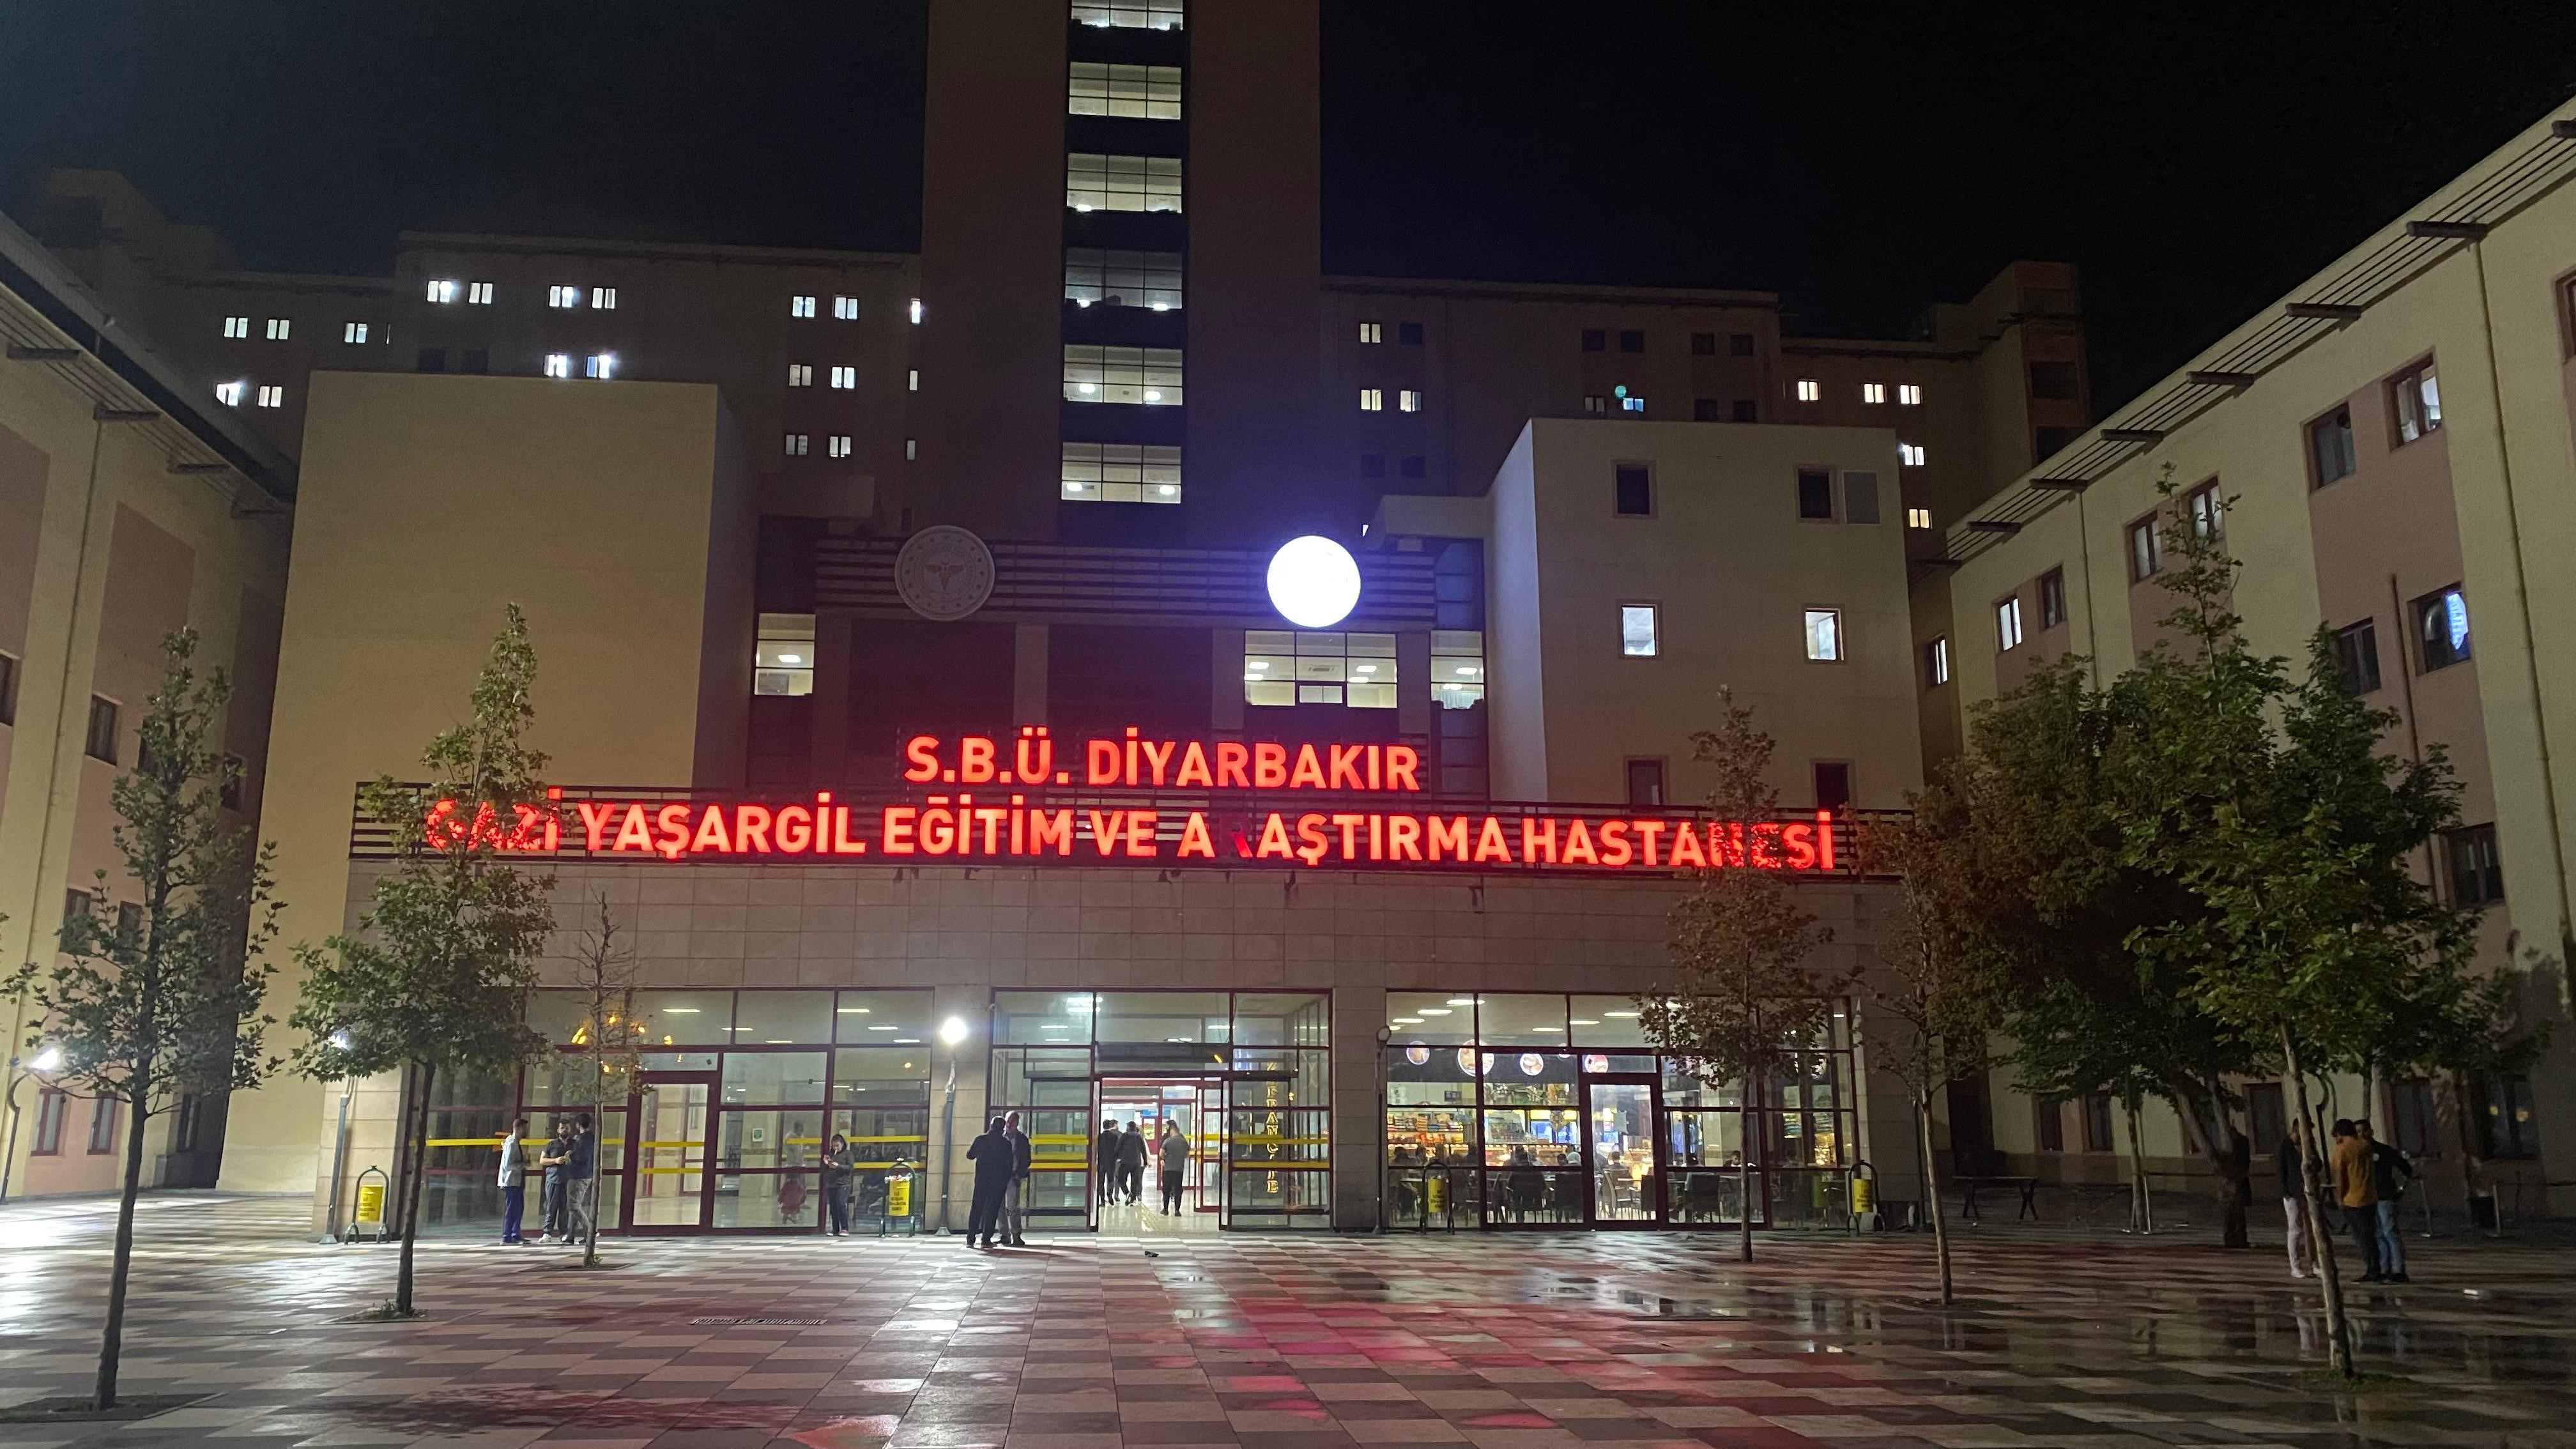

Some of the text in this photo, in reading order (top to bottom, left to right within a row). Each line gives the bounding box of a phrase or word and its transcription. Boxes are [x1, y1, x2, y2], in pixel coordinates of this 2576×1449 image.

[1087, 726, 1421, 791] DİYARBAKIR
[576, 791, 867, 860] YAŞARGİL
[882, 793, 1073, 857] EĞİTİM
[1087, 809, 1159, 857] VE
[1520, 810, 1836, 871] HASTANESİ
